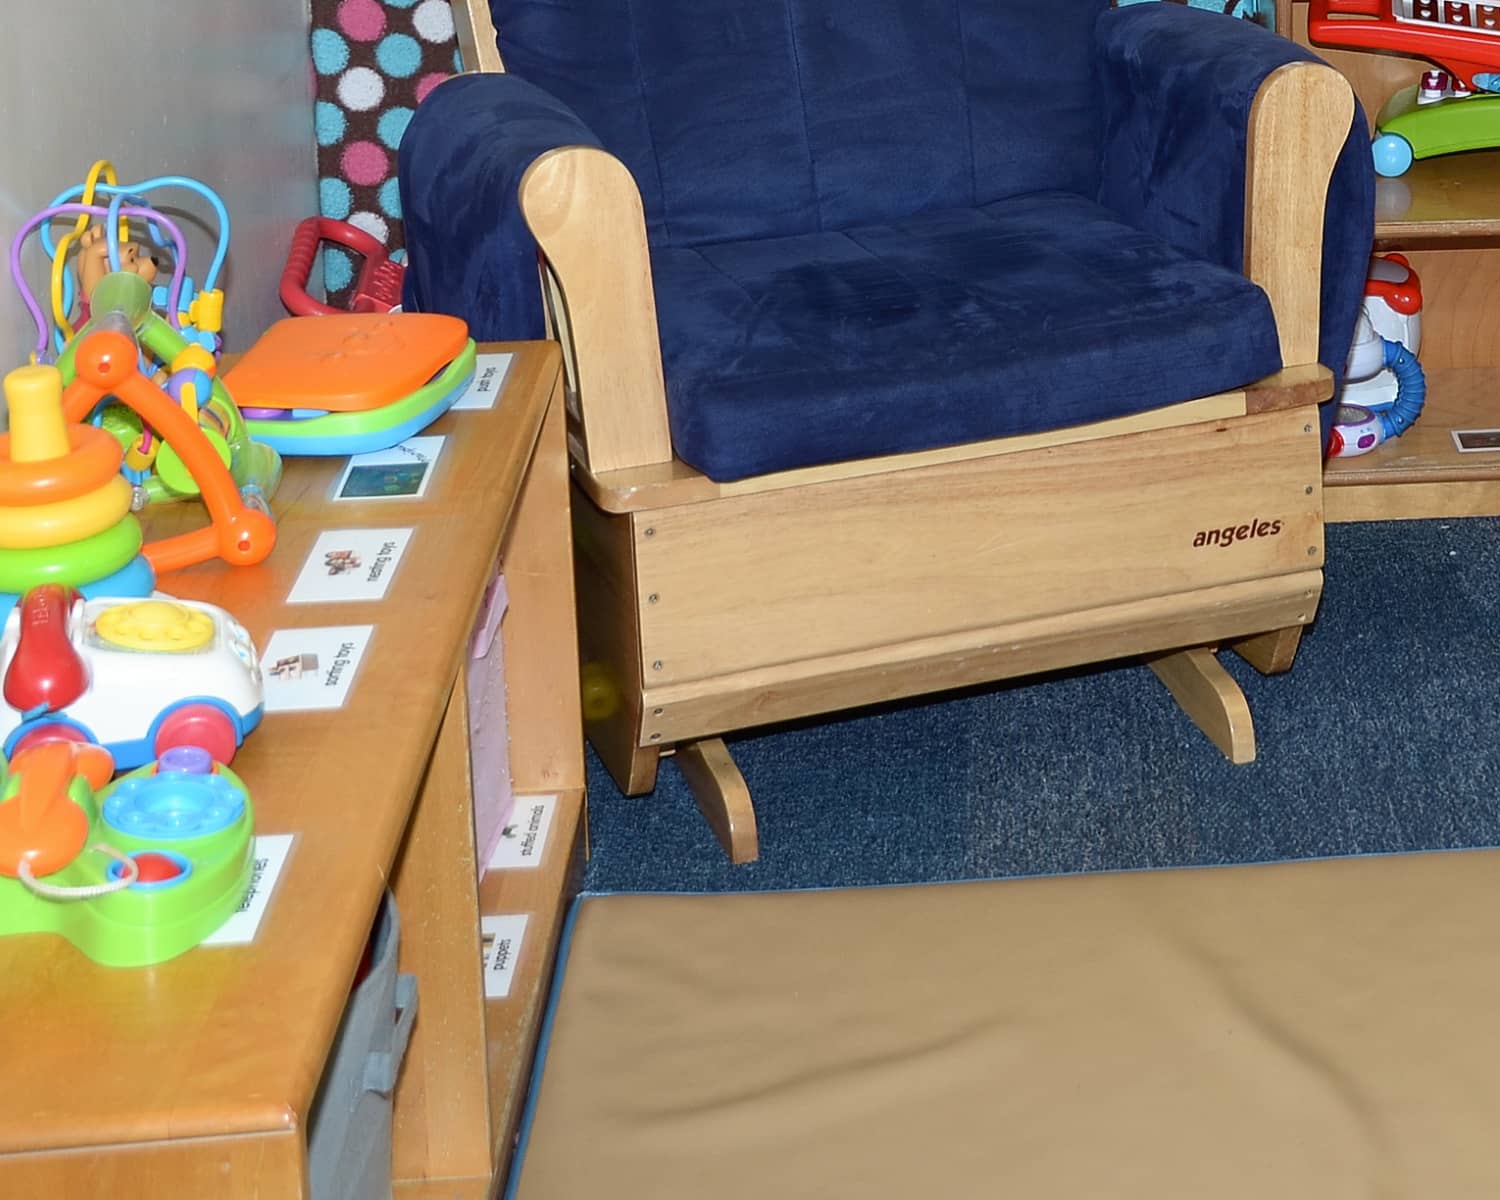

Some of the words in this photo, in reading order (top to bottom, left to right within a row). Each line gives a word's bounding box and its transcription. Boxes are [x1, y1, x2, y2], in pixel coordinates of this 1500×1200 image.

[1192, 517, 1282, 548] angeles
[376, 541, 398, 557] toys
[366, 557, 393, 582] nesting
[335, 642, 355, 659] toys
[324, 659, 352, 686] sorting
[519, 832, 537, 857] stuffed
[528, 804, 546, 832] animals
[493, 937, 512, 971] puppets
